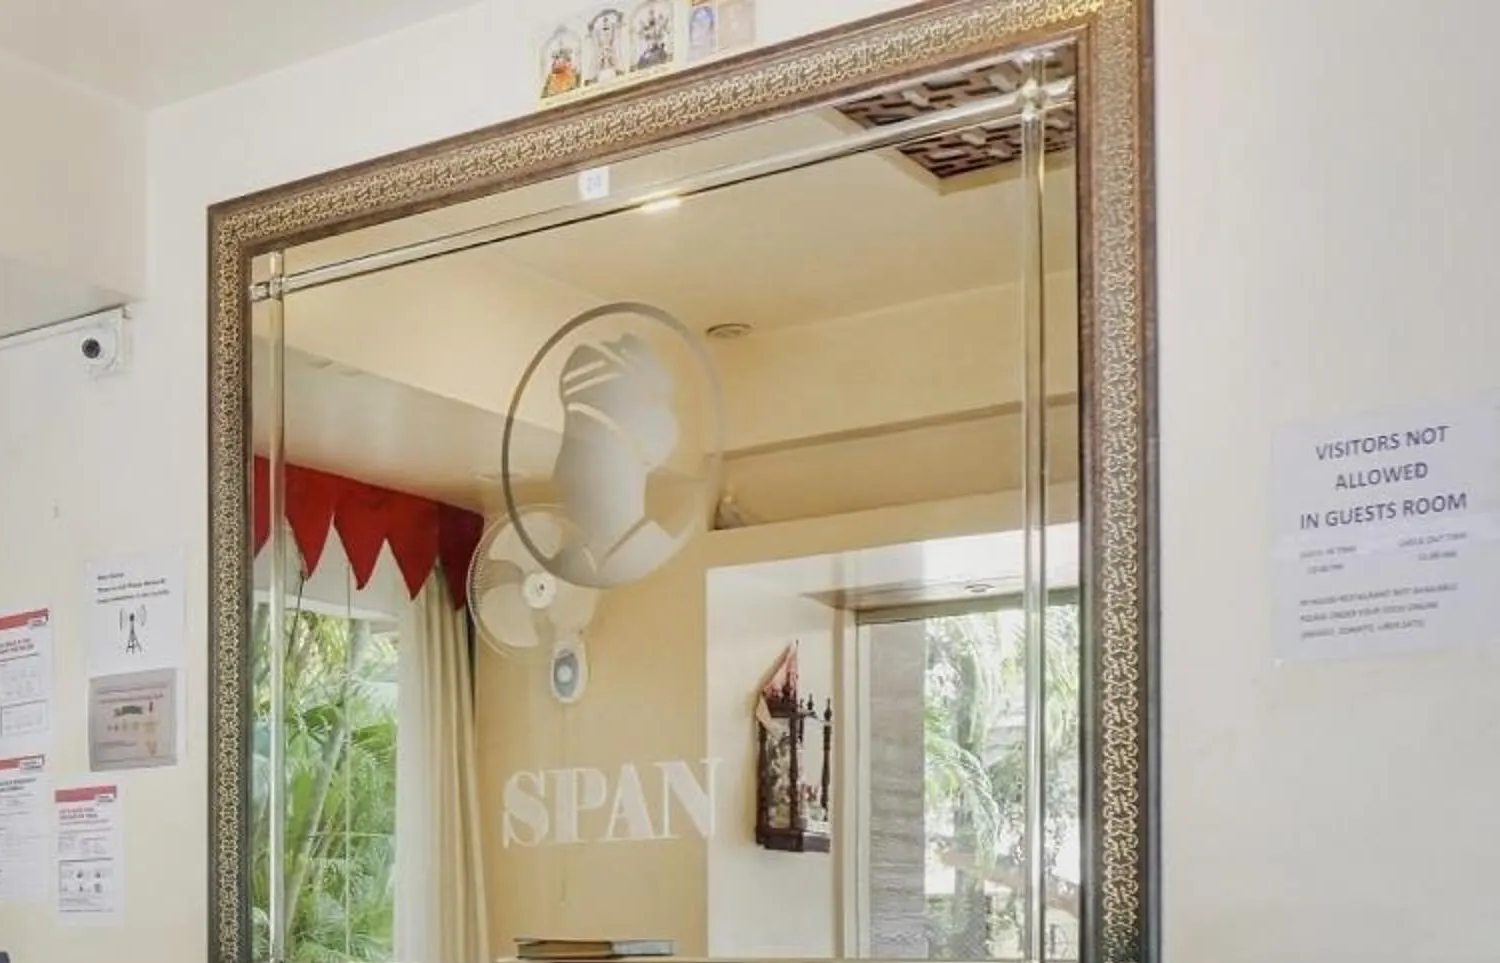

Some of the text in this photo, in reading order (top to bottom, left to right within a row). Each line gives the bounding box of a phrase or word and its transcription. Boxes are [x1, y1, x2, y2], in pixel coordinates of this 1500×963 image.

[1315, 425, 1450, 461] VISITORS NOT
[1335, 461, 1428, 491] ALLOWED
[1300, 492, 1467, 530] IN GUESTS ROOM
[503, 757, 723, 849] SPAN
